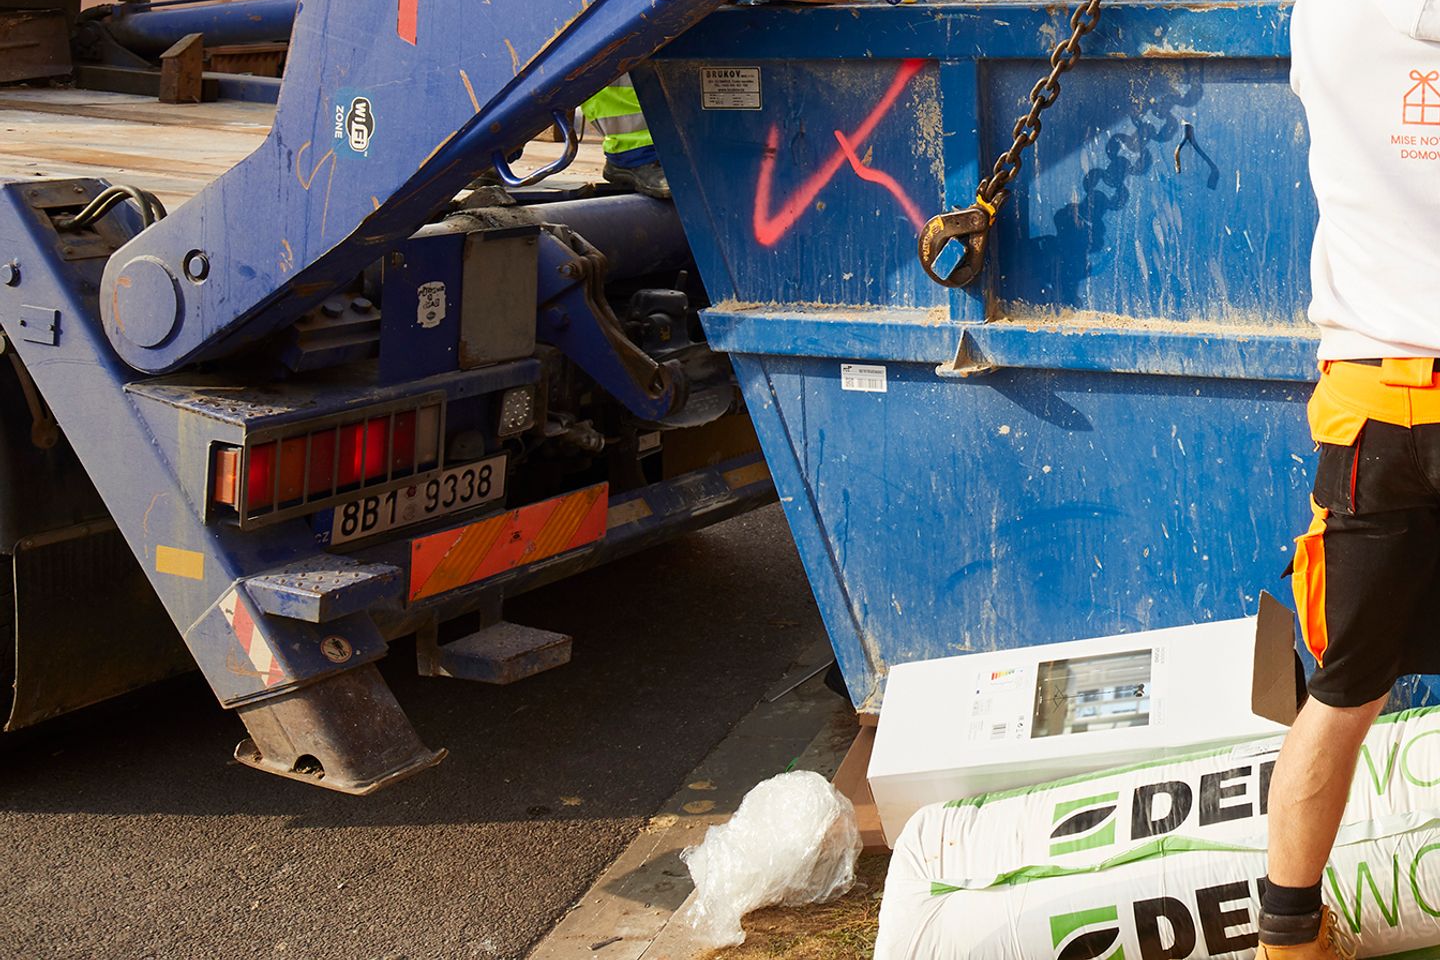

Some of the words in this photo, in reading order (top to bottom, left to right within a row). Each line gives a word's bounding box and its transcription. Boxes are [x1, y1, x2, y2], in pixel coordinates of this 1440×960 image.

[334, 105, 344, 139] ZONE
[1390, 135, 1417, 145] MISE
[341, 490, 398, 536] 8B1
[425, 465, 493, 513] 9338
